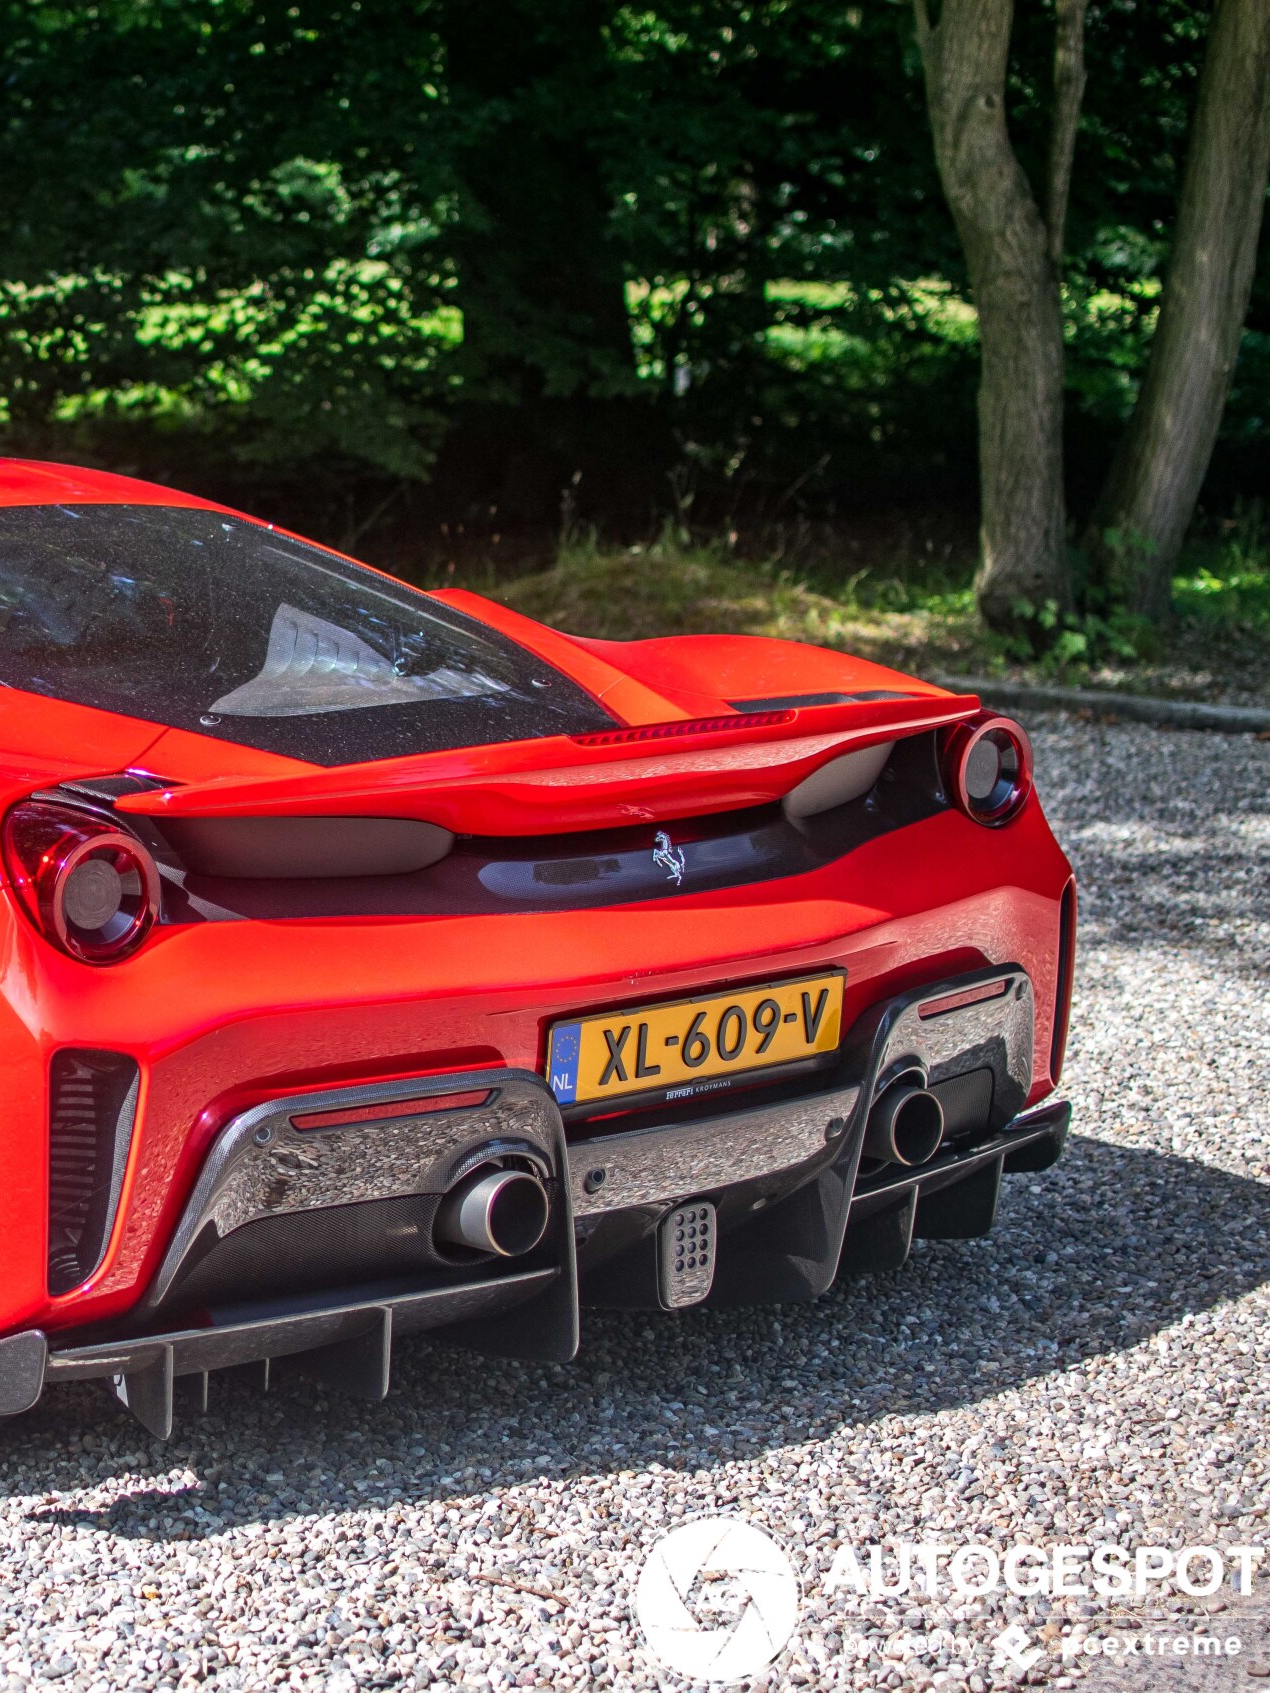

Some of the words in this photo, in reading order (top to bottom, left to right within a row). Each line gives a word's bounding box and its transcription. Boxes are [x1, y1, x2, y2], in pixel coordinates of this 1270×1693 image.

[598, 988, 829, 1085] XL-609-V
[552, 1073, 573, 1092] NL
[666, 1086, 694, 1100] Ferrari
[695, 1080, 732, 1093] KROYMANS
